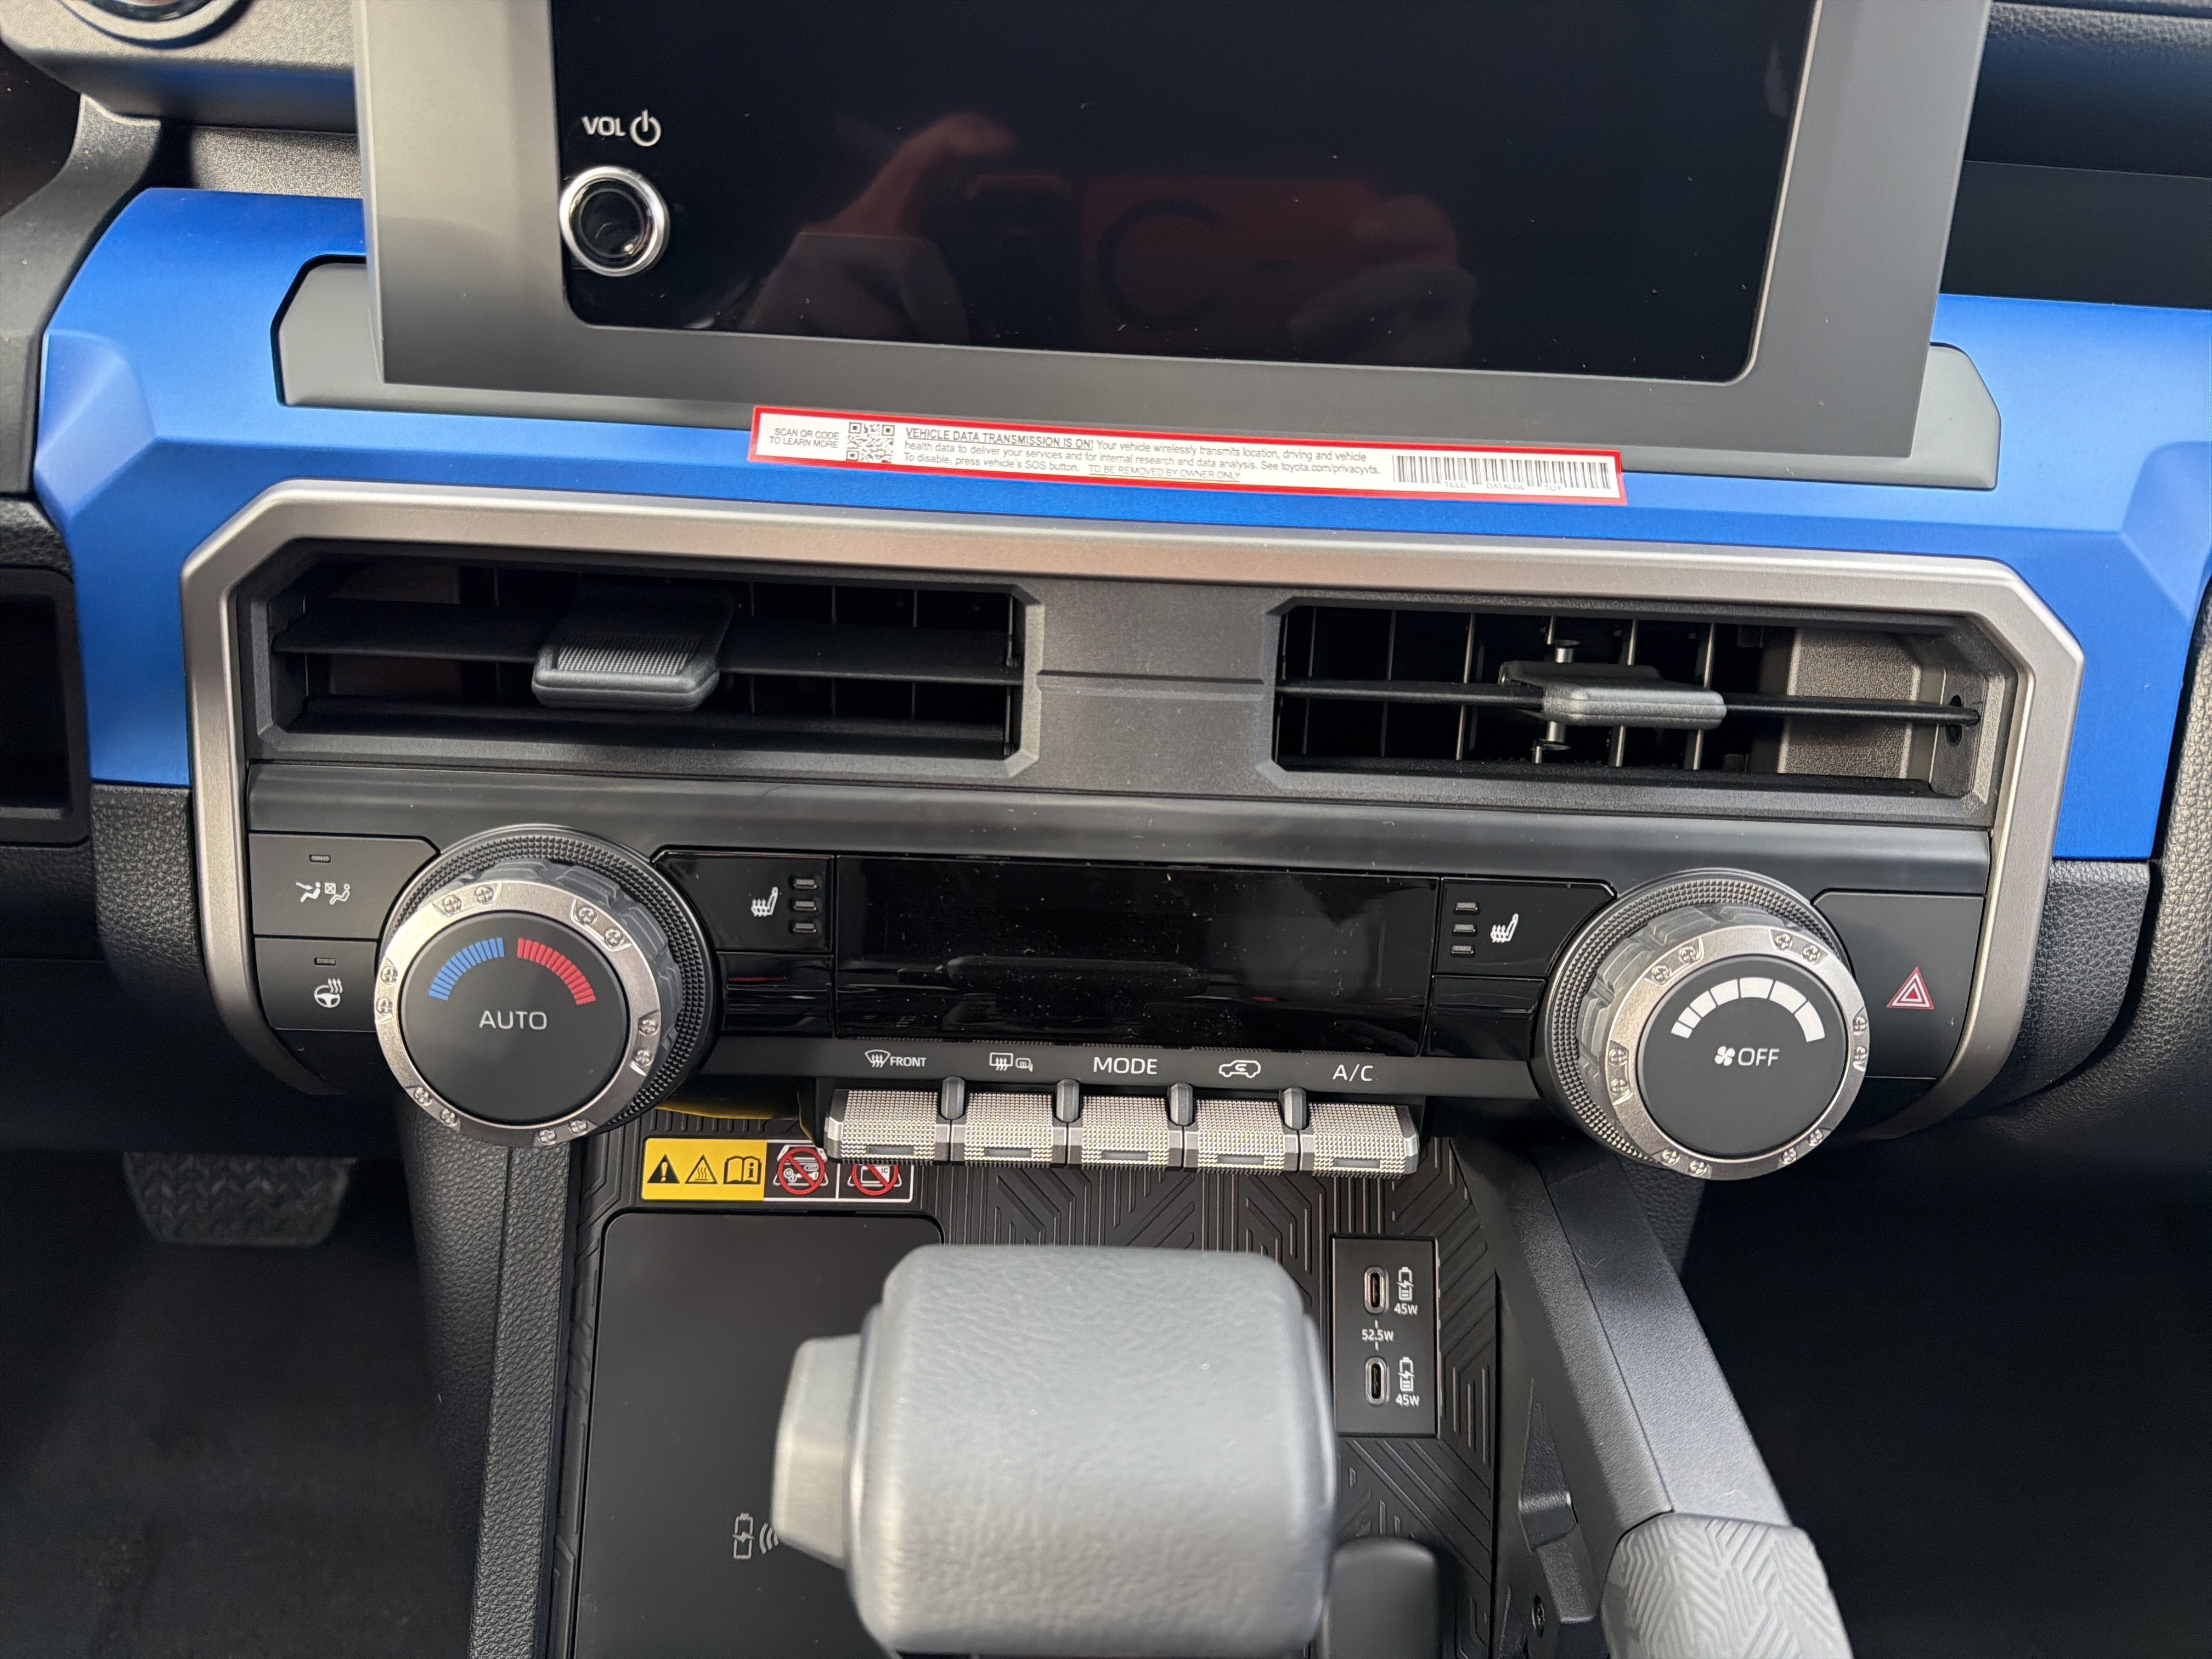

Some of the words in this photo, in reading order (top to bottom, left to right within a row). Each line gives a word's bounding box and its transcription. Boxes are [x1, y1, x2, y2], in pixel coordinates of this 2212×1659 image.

[582, 115, 626, 137] VOL
[769, 436, 781, 444] TO
[783, 437, 811, 447] LEARN
[813, 439, 838, 449] MORE
[775, 427, 798, 437] SCAN
[815, 431, 839, 441] CODE
[905, 427, 950, 439] VEHICLE
[953, 431, 980, 442] DATA
[982, 432, 1060, 447] TRANSMISSION
[1063, 438, 1073, 448] IS
[1076, 438, 1093, 449] ON!
[1097, 440, 1117, 450] Your
[1120, 442, 1150, 452] vehicle
[1154, 443, 1197, 456] wirelessly
[1200, 446, 1240, 456] transmits
[1243, 447, 1280, 459] location,
[1283, 450, 1312, 462] driving
[1316, 451, 1332, 461] and
[1335, 451, 1366, 462] vehicle
[905, 441, 932, 451] health
[935, 443, 955, 453] data
[958, 445, 967, 454] to
[970, 445, 1000, 455] deliver
[1003, 448, 1023, 458] your
[1025, 449, 1062, 459] services
[1065, 452, 1082, 461] and
[1085, 452, 1097, 461] for
[1100, 453, 1133, 464] internal
[1136, 456, 1174, 465] research
[1177, 458, 1194, 466] and
[1197, 458, 1216, 467] data
[1219, 460, 1258, 470] analysis.
[1261, 460, 1278, 470] See
[904, 452, 915, 461] To
[955, 457, 980, 466] press
[984, 458, 1022, 469] vehicle's
[1025, 460, 1046, 470] SOS
[1049, 461, 1080, 472] button.
[1088, 464, 1101, 473] TO
[1104, 465, 1115, 474] BE
[1118, 466, 1164, 476] REMOVED
[1166, 468, 1178, 477] BY
[1180, 469, 1215, 478] OWNER
[1217, 470, 1241, 479] ONLY
[479, 1011, 548, 1030] AUTO
[890, 1055, 927, 1069] FRONT
[1737, 1047, 1780, 1066] OFF
[1093, 1056, 1158, 1076] MODE
[1333, 1064, 1374, 1082] A/C
[1393, 1303, 1419, 1316] 45W
[1362, 1329, 1394, 1342] 52.5W
[1395, 1393, 1420, 1407] 45W
